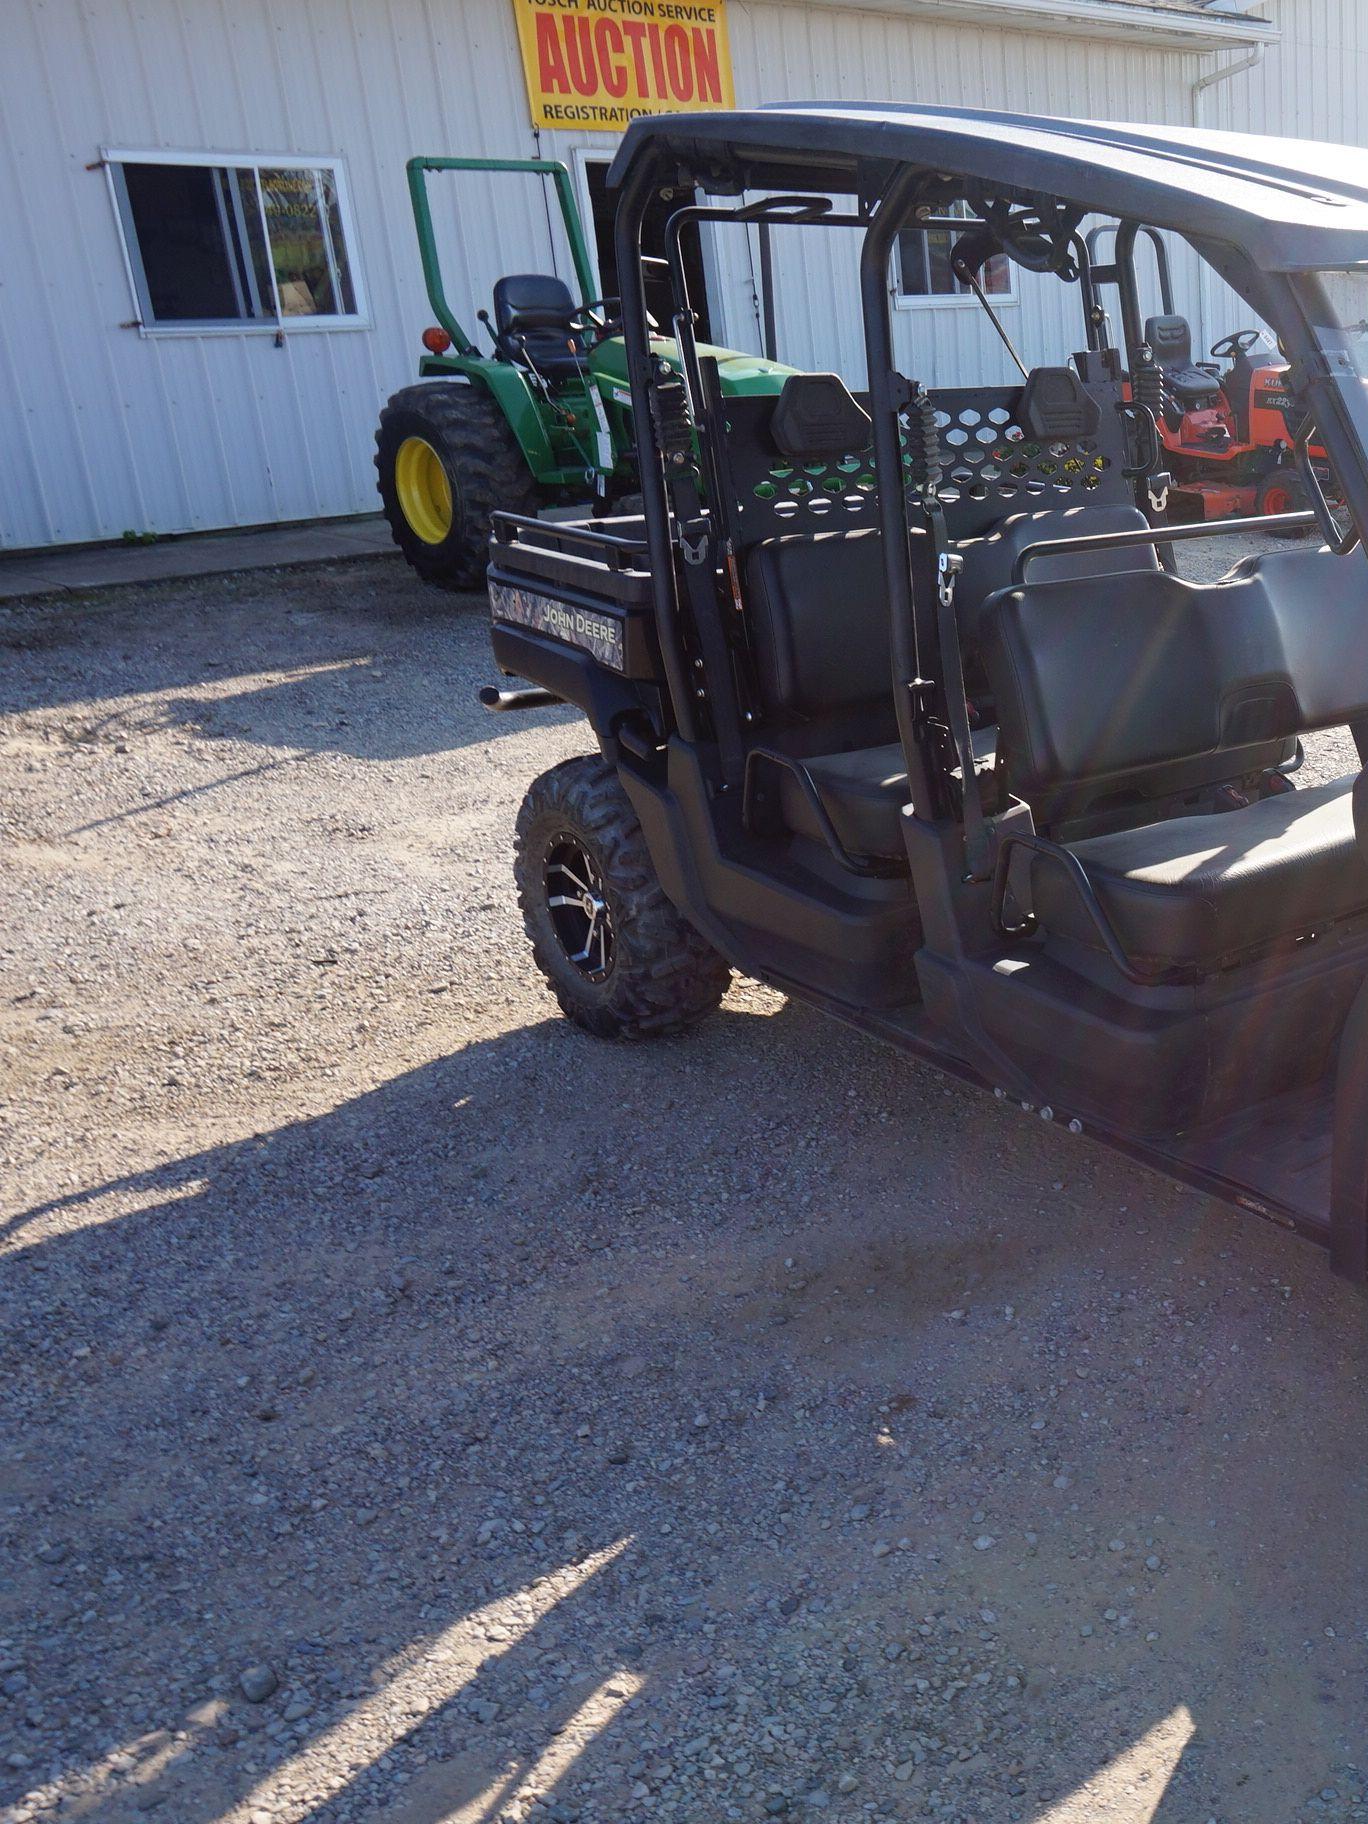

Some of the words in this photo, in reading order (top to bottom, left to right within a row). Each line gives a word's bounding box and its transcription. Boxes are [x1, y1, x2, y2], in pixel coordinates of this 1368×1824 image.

[527, 0, 579, 9] SCH
[586, 0, 654, 17] AUCTION
[658, 4, 716, 23] SERVICE
[535, 12, 723, 103] AUCTION
[543, 605, 574, 631] JOHN
[576, 613, 616, 643] DEERE
